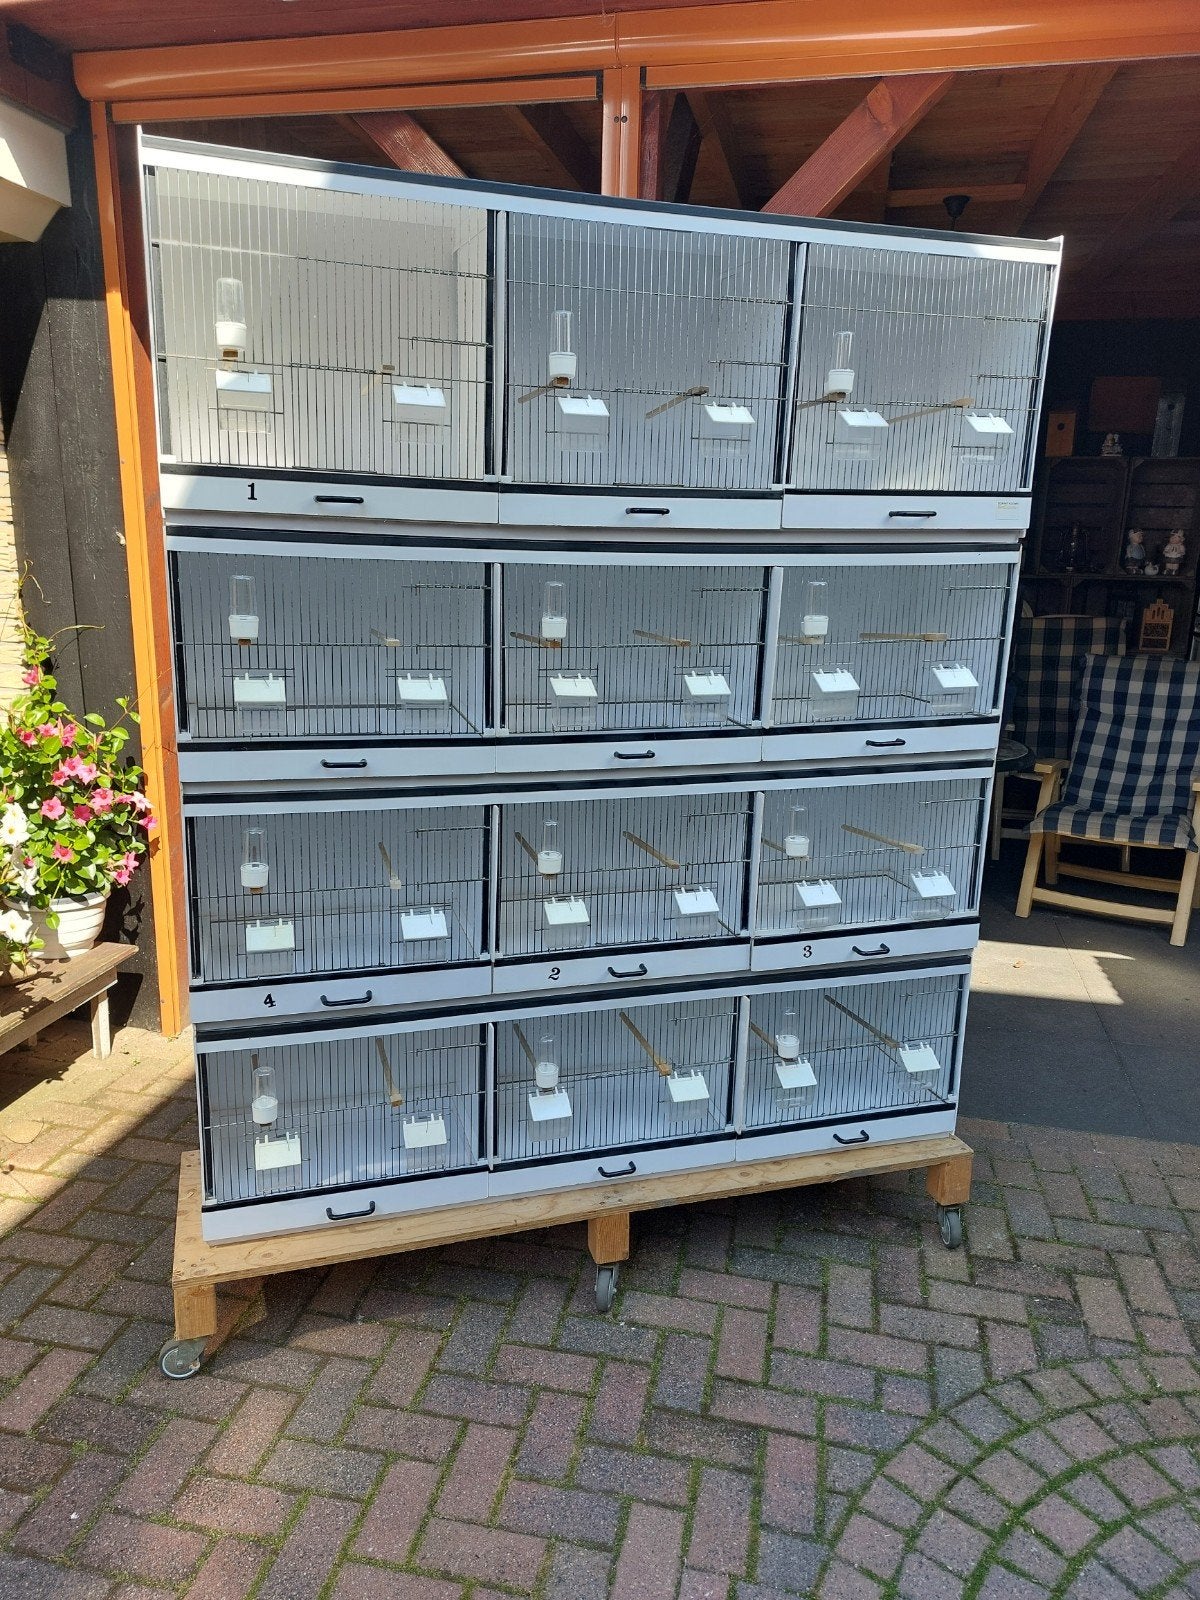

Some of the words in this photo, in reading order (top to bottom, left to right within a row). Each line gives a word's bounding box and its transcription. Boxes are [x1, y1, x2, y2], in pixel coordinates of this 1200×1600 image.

[247, 482, 258, 501] 1
[803, 944, 813, 958] 3
[548, 966, 561, 981] 2
[263, 992, 277, 1008] 4
